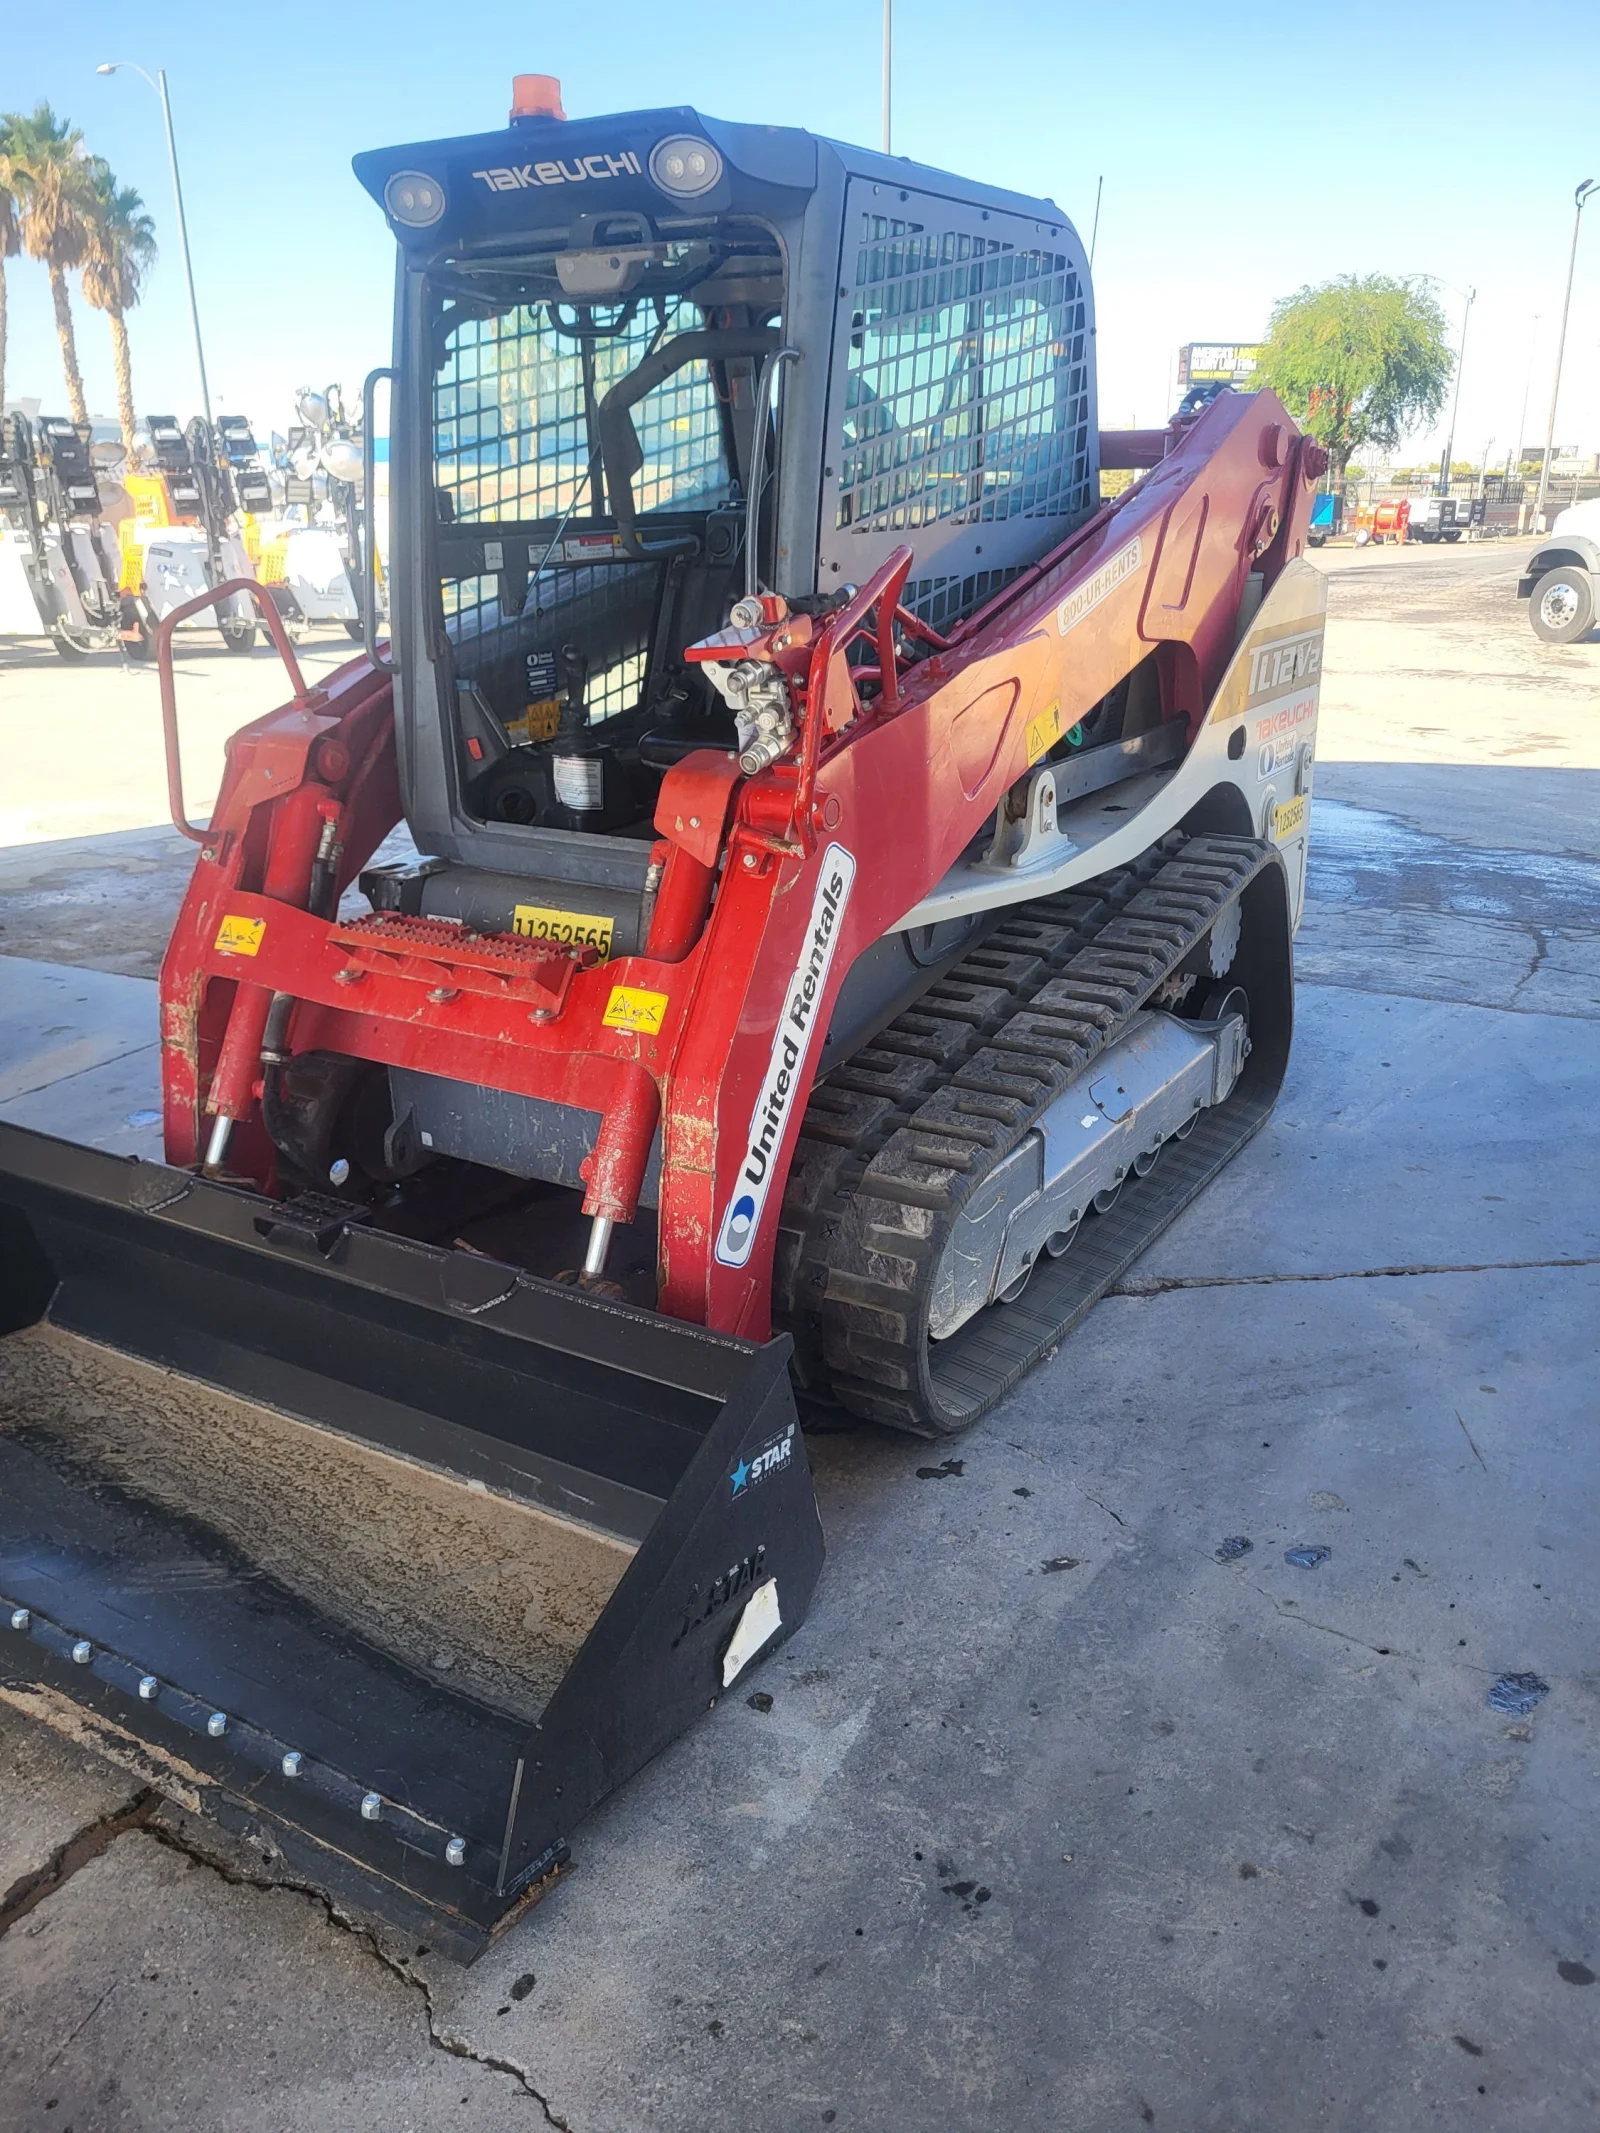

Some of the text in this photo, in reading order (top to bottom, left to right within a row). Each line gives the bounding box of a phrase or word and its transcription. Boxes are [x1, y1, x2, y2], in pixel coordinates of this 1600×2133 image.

[472, 151, 642, 192] TAKEUCHI
[1063, 545, 1138, 626] 800-UR-RENTS
[1256, 698, 1314, 740] TAKEUCHI
[1274, 752, 1295, 769] Rentals
[1275, 734, 1295, 754] United
[745, 871, 843, 1186] United Rentals
[751, 1438, 791, 1479] STAR
